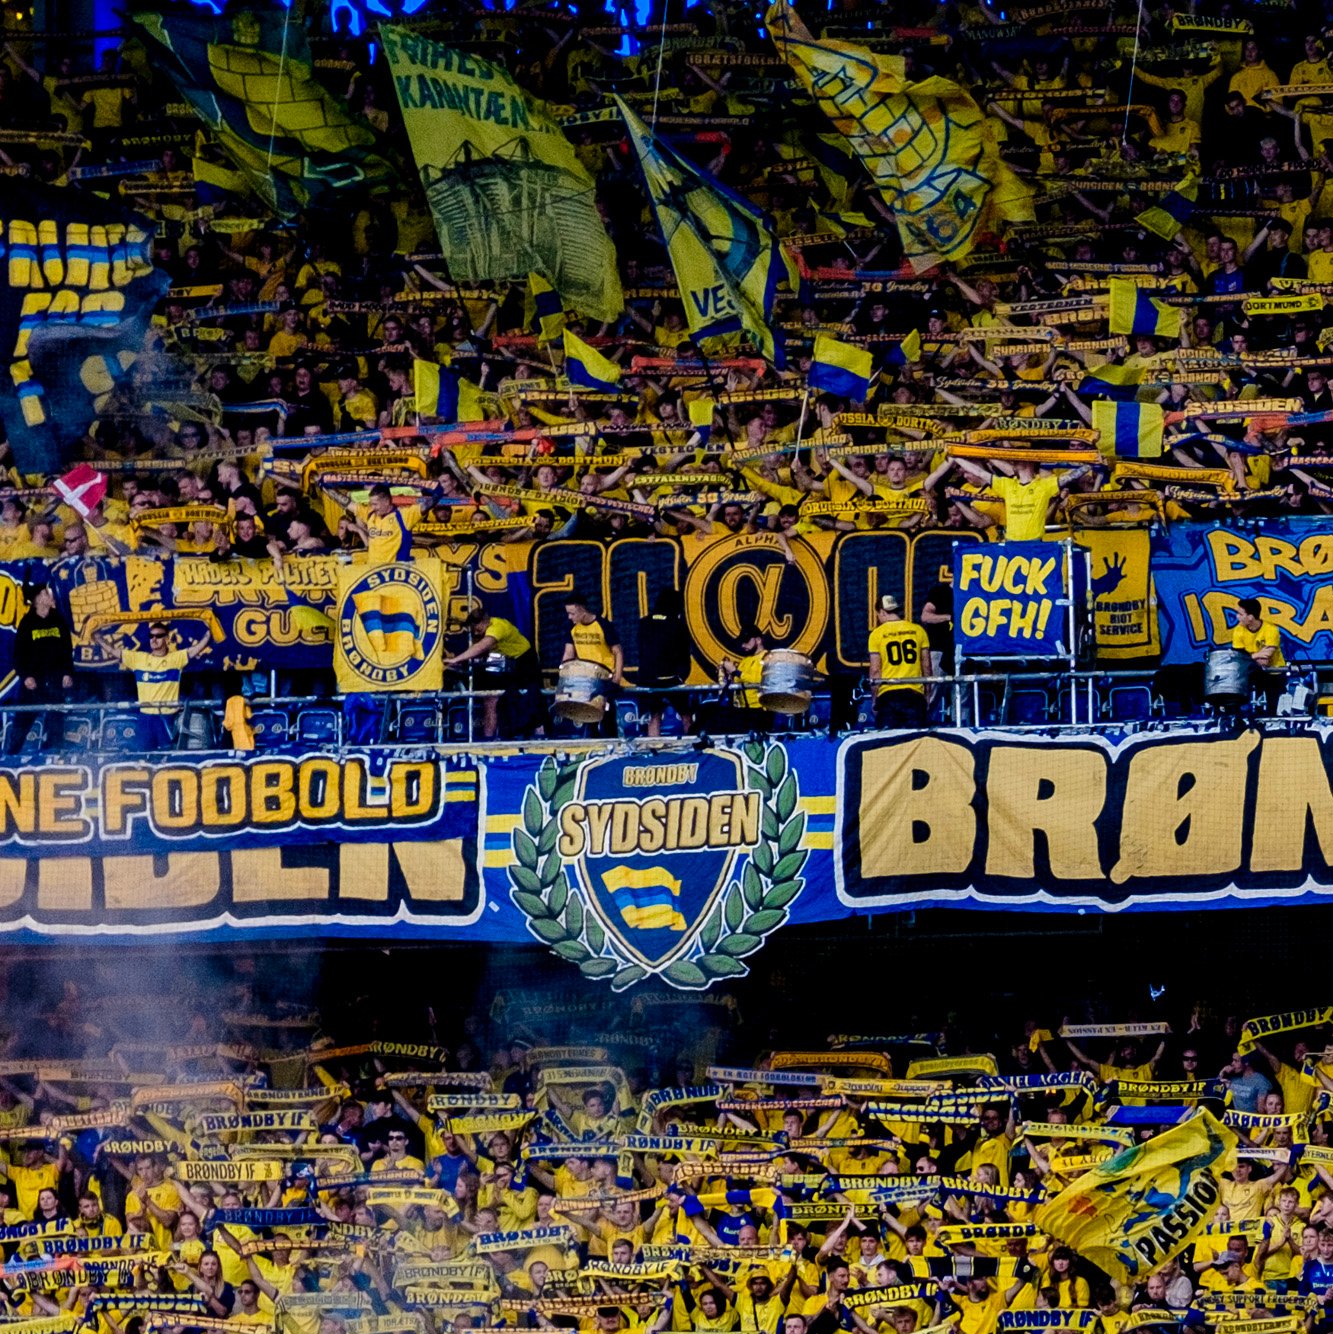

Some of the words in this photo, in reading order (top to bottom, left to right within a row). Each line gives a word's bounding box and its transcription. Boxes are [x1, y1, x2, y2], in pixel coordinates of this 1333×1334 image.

[958, 554, 1050, 595] FUCK
[962, 599, 1051, 639] GFH!
[1100, 623, 1144, 637] SERVICE
[887, 641, 917, 665] 06
[622, 763, 697, 785] BRØNDBY
[559, 793, 760, 855] SYDSIDEN
